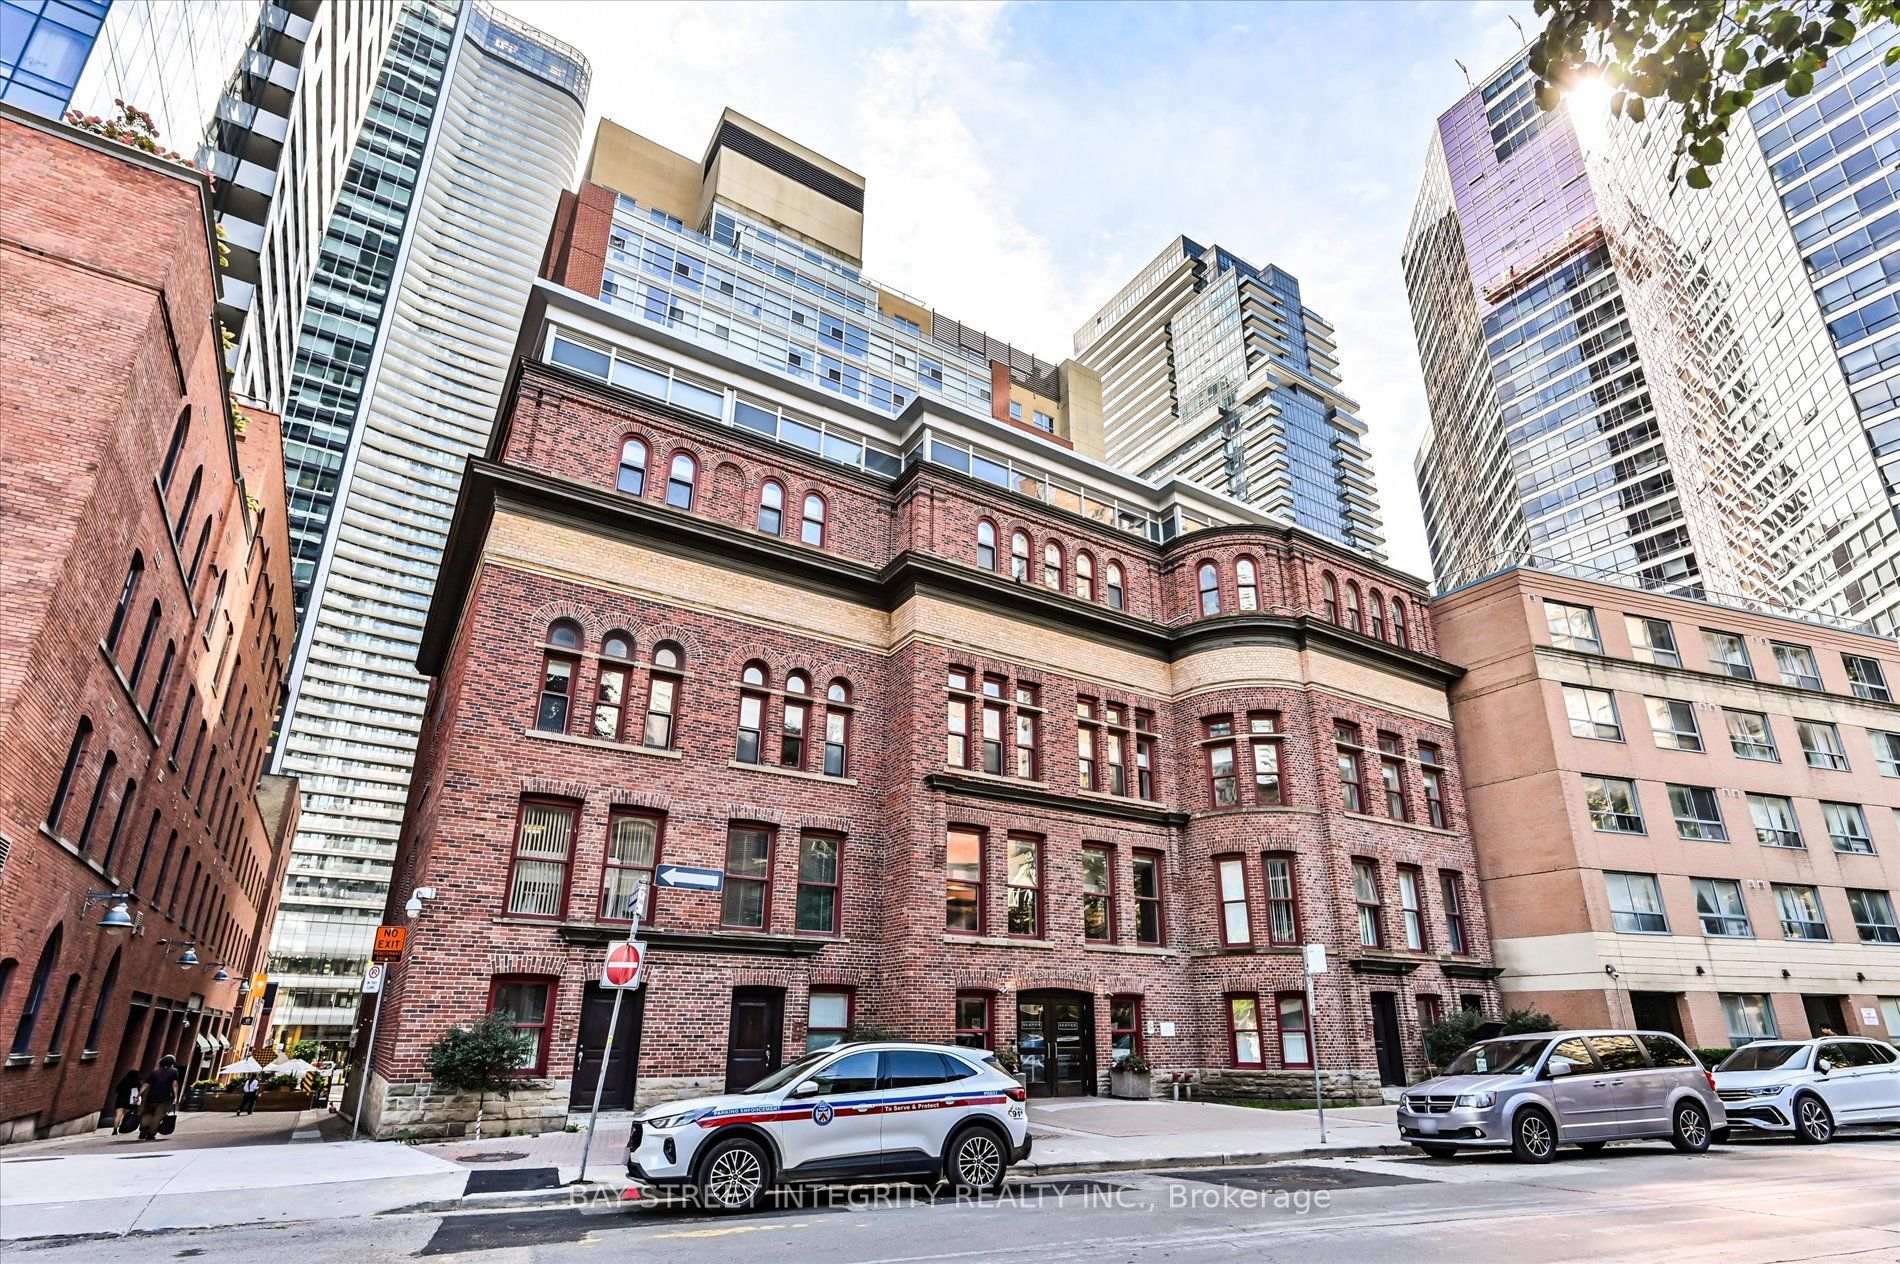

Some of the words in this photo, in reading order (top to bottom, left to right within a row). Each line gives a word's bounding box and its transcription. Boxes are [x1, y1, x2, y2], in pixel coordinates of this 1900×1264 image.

[384, 929, 398, 937] NO
[378, 940, 400, 949] EXIT
[917, 1102, 940, 1110] Protect
